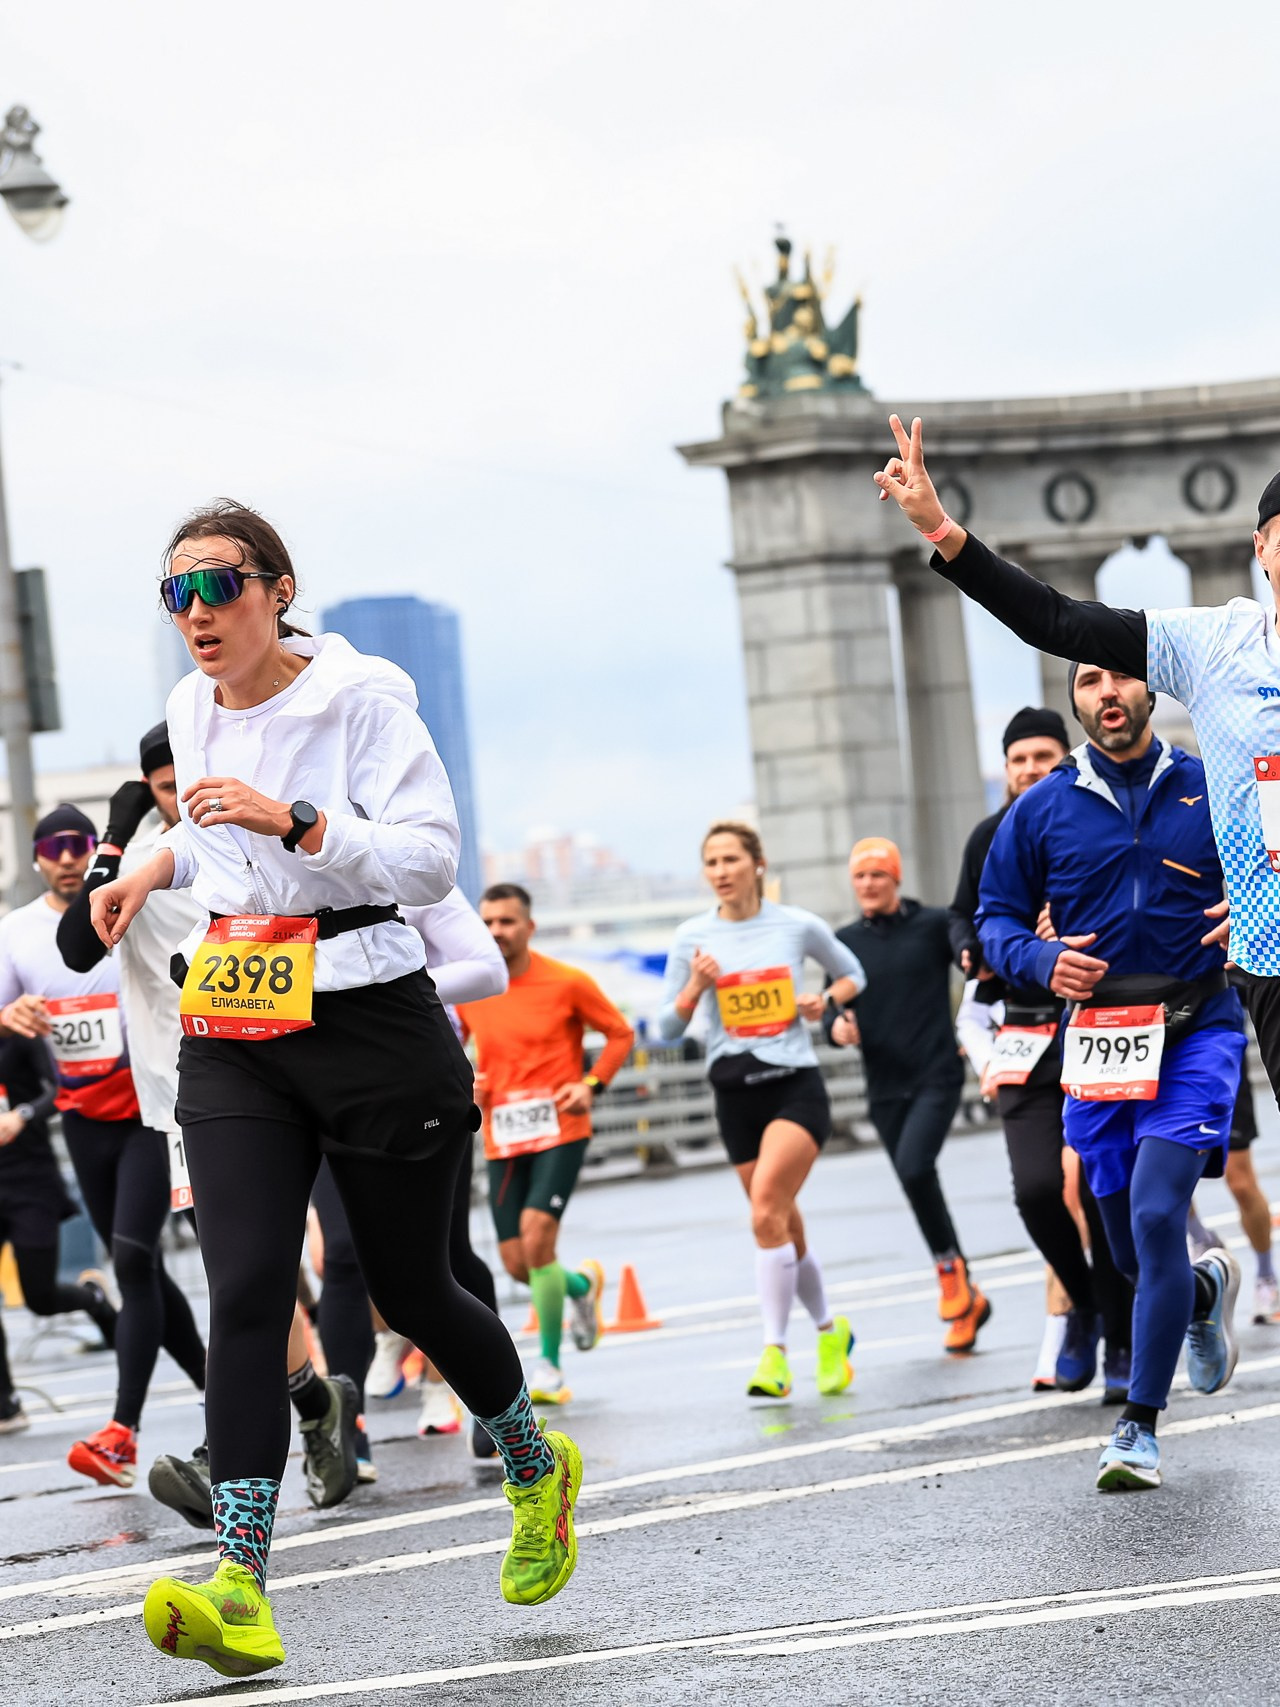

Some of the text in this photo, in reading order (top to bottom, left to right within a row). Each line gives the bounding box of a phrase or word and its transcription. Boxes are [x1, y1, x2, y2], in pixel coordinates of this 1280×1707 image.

[198, 954, 294, 995] 2398
[211, 997, 275, 1011] ЕЛИЗАВЕТА
[727, 988, 782, 1015] 3301
[191, 1016, 209, 1036] D
[1079, 1035, 1150, 1065] 7995
[424, 1118, 440, 1130] FULL
